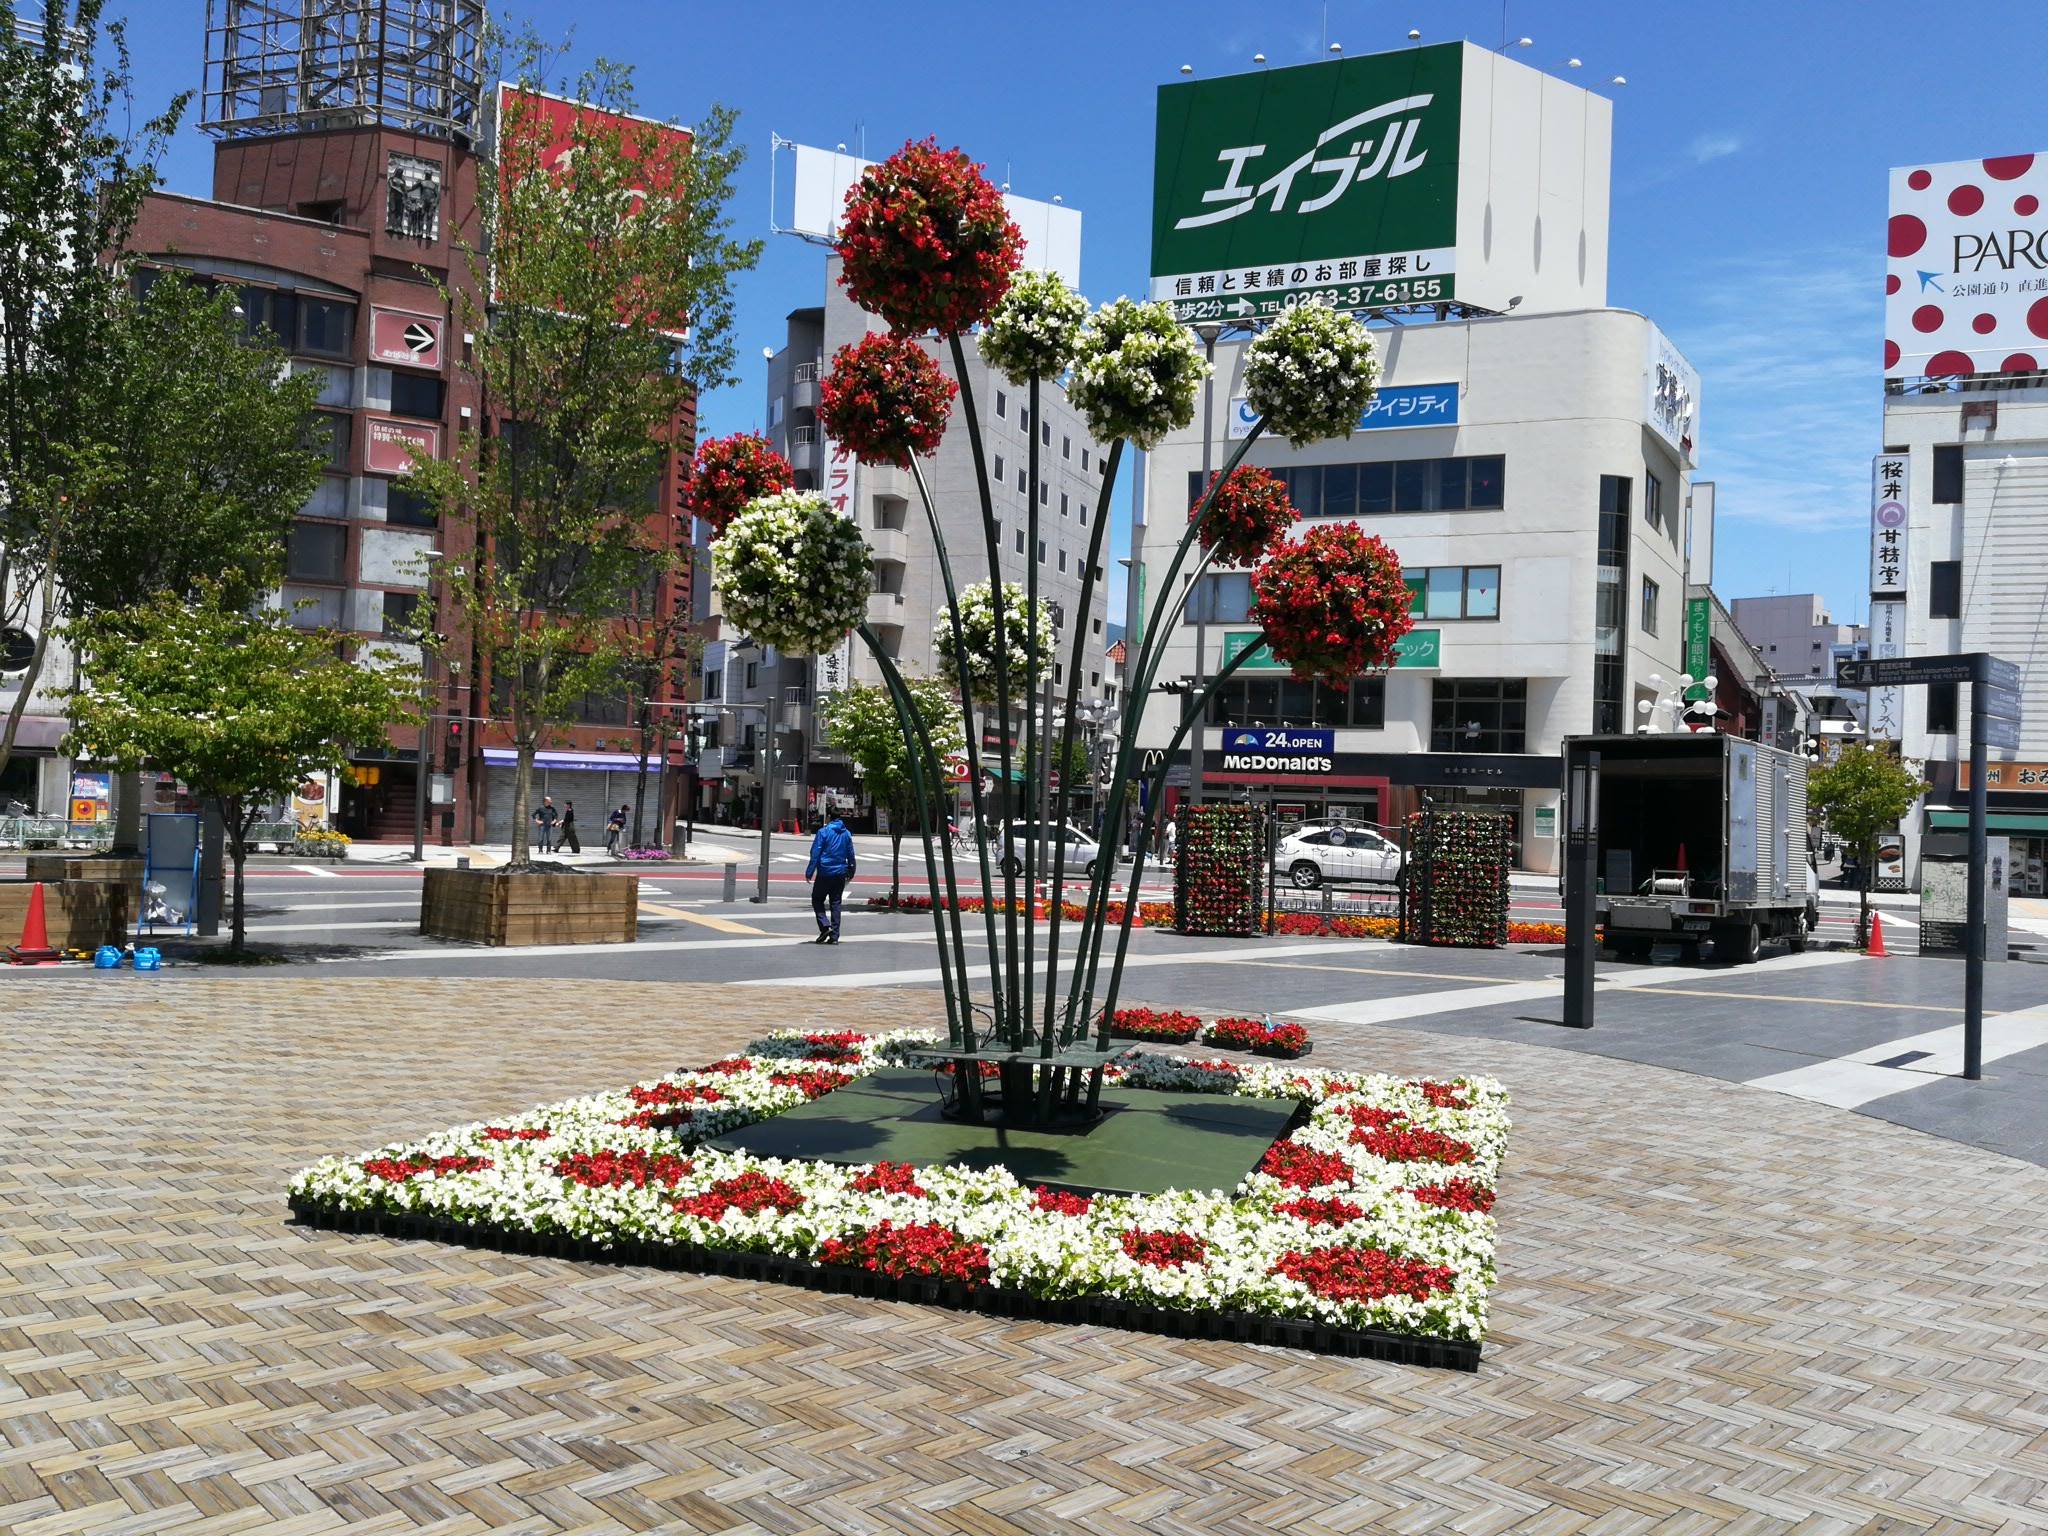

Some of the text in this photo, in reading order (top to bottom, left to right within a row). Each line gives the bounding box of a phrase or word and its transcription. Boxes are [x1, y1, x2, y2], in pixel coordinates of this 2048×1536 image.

[1174, 94, 1434, 230] エイブル
[1175, 254, 1431, 296] 信頼と実績のお部屋探し
[1953, 280, 2009, 297] 公園通り
[1260, 300, 1281, 312] TEL
[1364, 395, 1450, 418] アイシティ
[1292, 739, 1322, 749] OPEN
[1223, 755, 1332, 772] McDonald's
